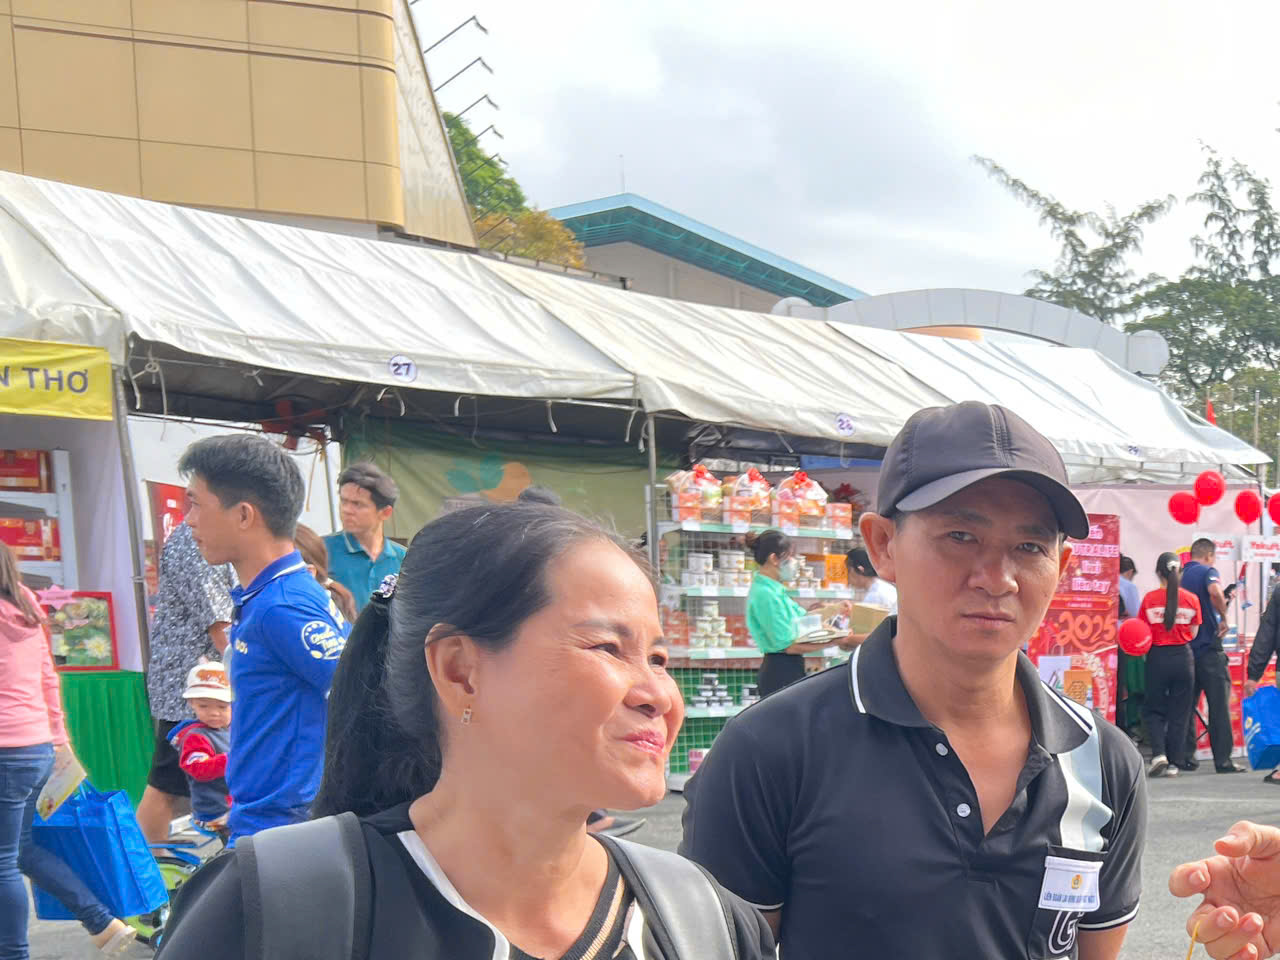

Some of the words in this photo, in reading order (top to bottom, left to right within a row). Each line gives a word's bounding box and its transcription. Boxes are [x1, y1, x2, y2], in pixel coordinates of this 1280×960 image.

[22, 367, 88, 393] THƠ
[392, 362, 412, 376] 27
[1056, 611, 1116, 648] 2025
